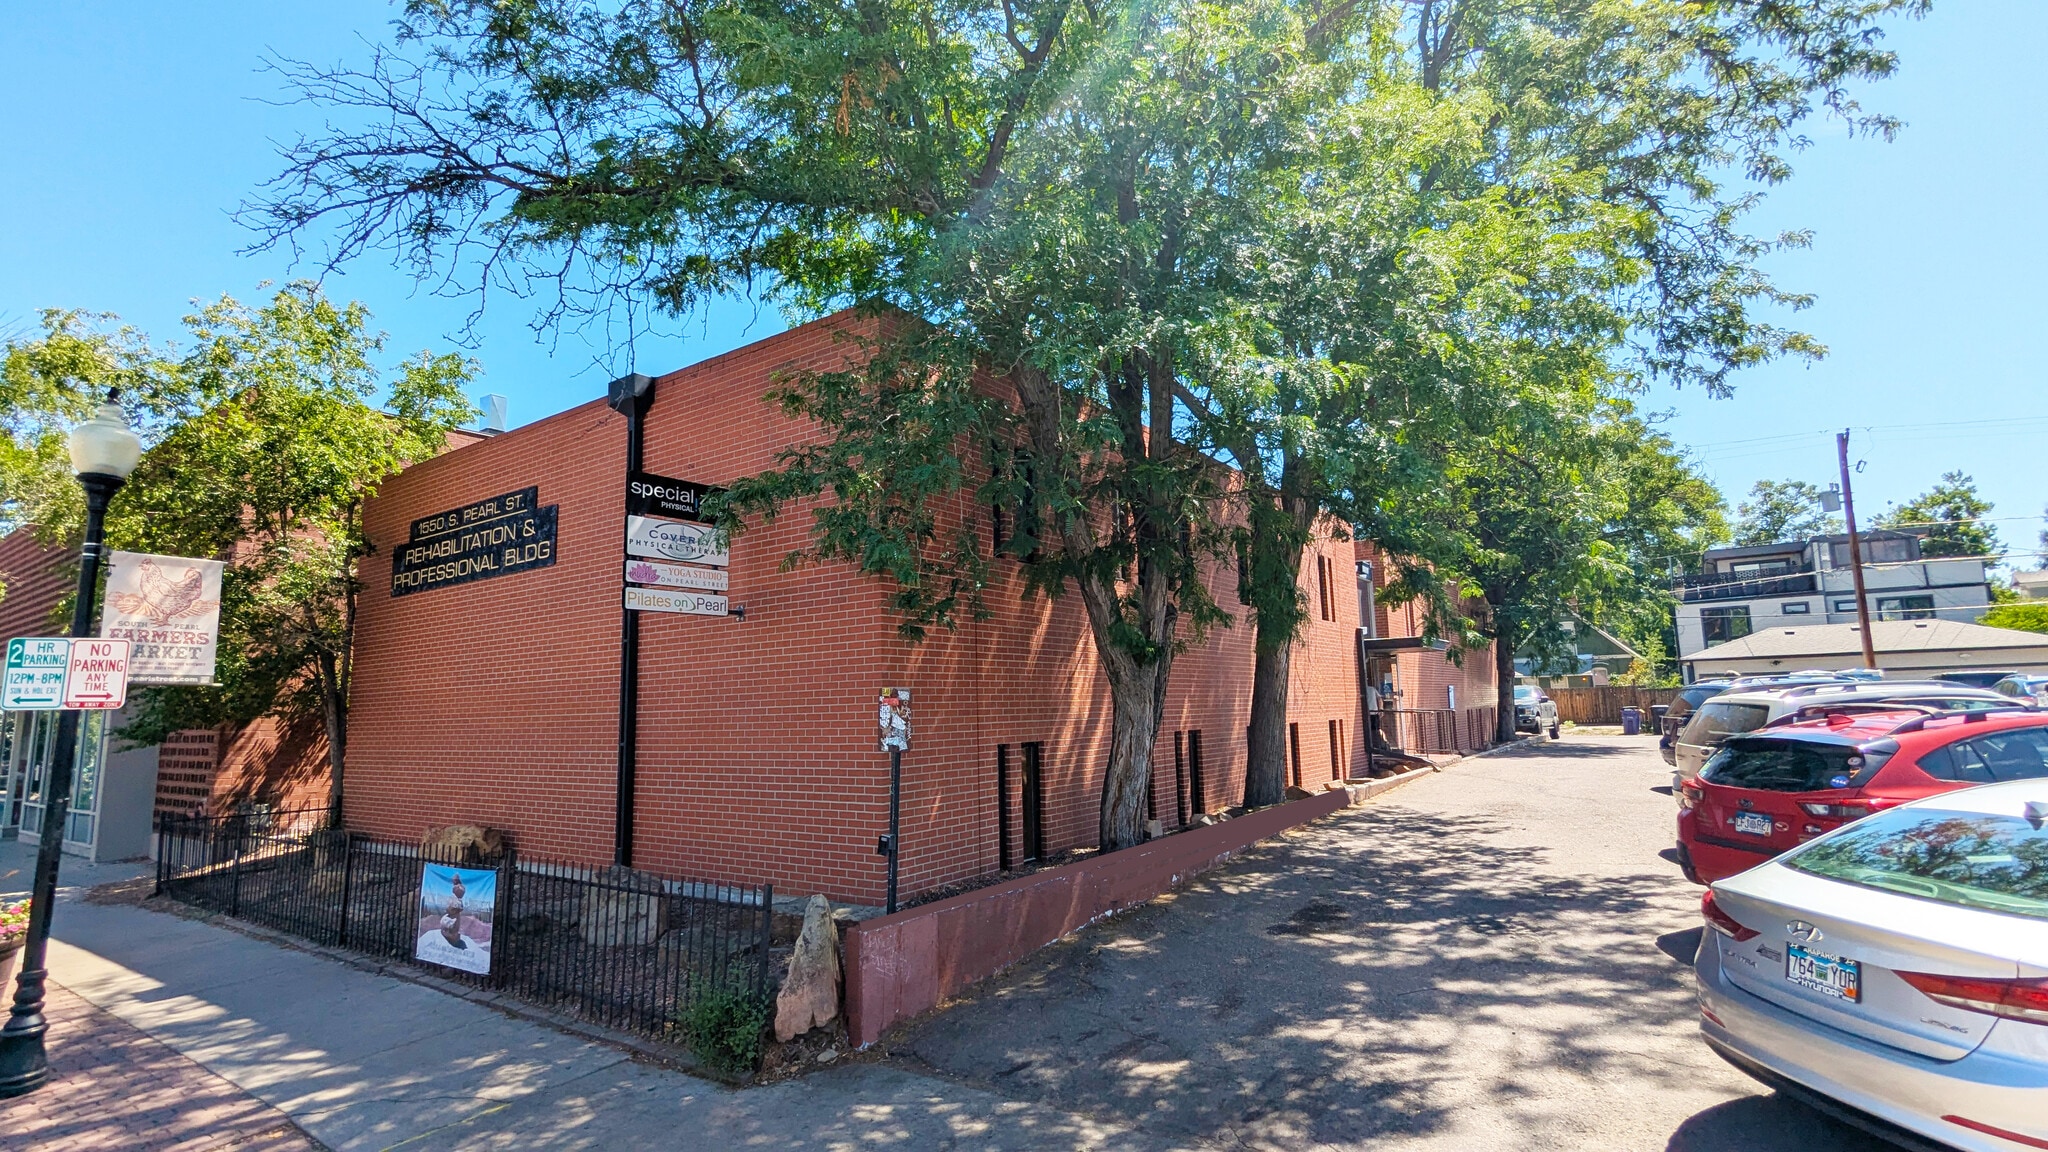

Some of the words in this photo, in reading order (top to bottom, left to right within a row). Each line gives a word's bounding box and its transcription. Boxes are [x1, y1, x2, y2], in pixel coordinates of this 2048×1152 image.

[661, 501, 694, 513] PHYSICAL
[418, 517, 444, 535] 1550
[449, 513, 458, 526] S.
[463, 501, 501, 523] PEARL
[506, 494, 525, 511] ST.
[405, 523, 516, 566] REHABILITATION
[522, 519, 536, 537] &
[629, 538, 680, 551] PHYSICAL
[394, 554, 499, 590] PROFESSIONAL
[505, 540, 551, 567] BLDG
[668, 567, 693, 578] YOGA
[693, 570, 723, 581] STUDIO
[676, 578, 698, 586] PEARL
[703, 579, 728, 588] STREET
[627, 591, 671, 607] Pilates
[674, 598, 688, 608] on
[696, 597, 727, 612] Pearl
[117, 620, 148, 629] SOUTH
[109, 628, 210, 645] FARMERS
[10, 644, 23, 663] 2
[37, 642, 55, 653] HR
[90, 643, 112, 657] NO
[131, 644, 202, 660] ARKET
[24, 654, 65, 665] PARKING
[73, 659, 124, 672] PARKING
[86, 673, 108, 682] ANY
[46, 687, 57, 695] EXC
[84, 682, 108, 691] TIME
[1803, 947, 1840, 962] ARAPAHOE
[1790, 954, 1814, 978] 764
[1830, 966, 1856, 989] YOR
[1801, 979, 1839, 998] HYUNDAI
